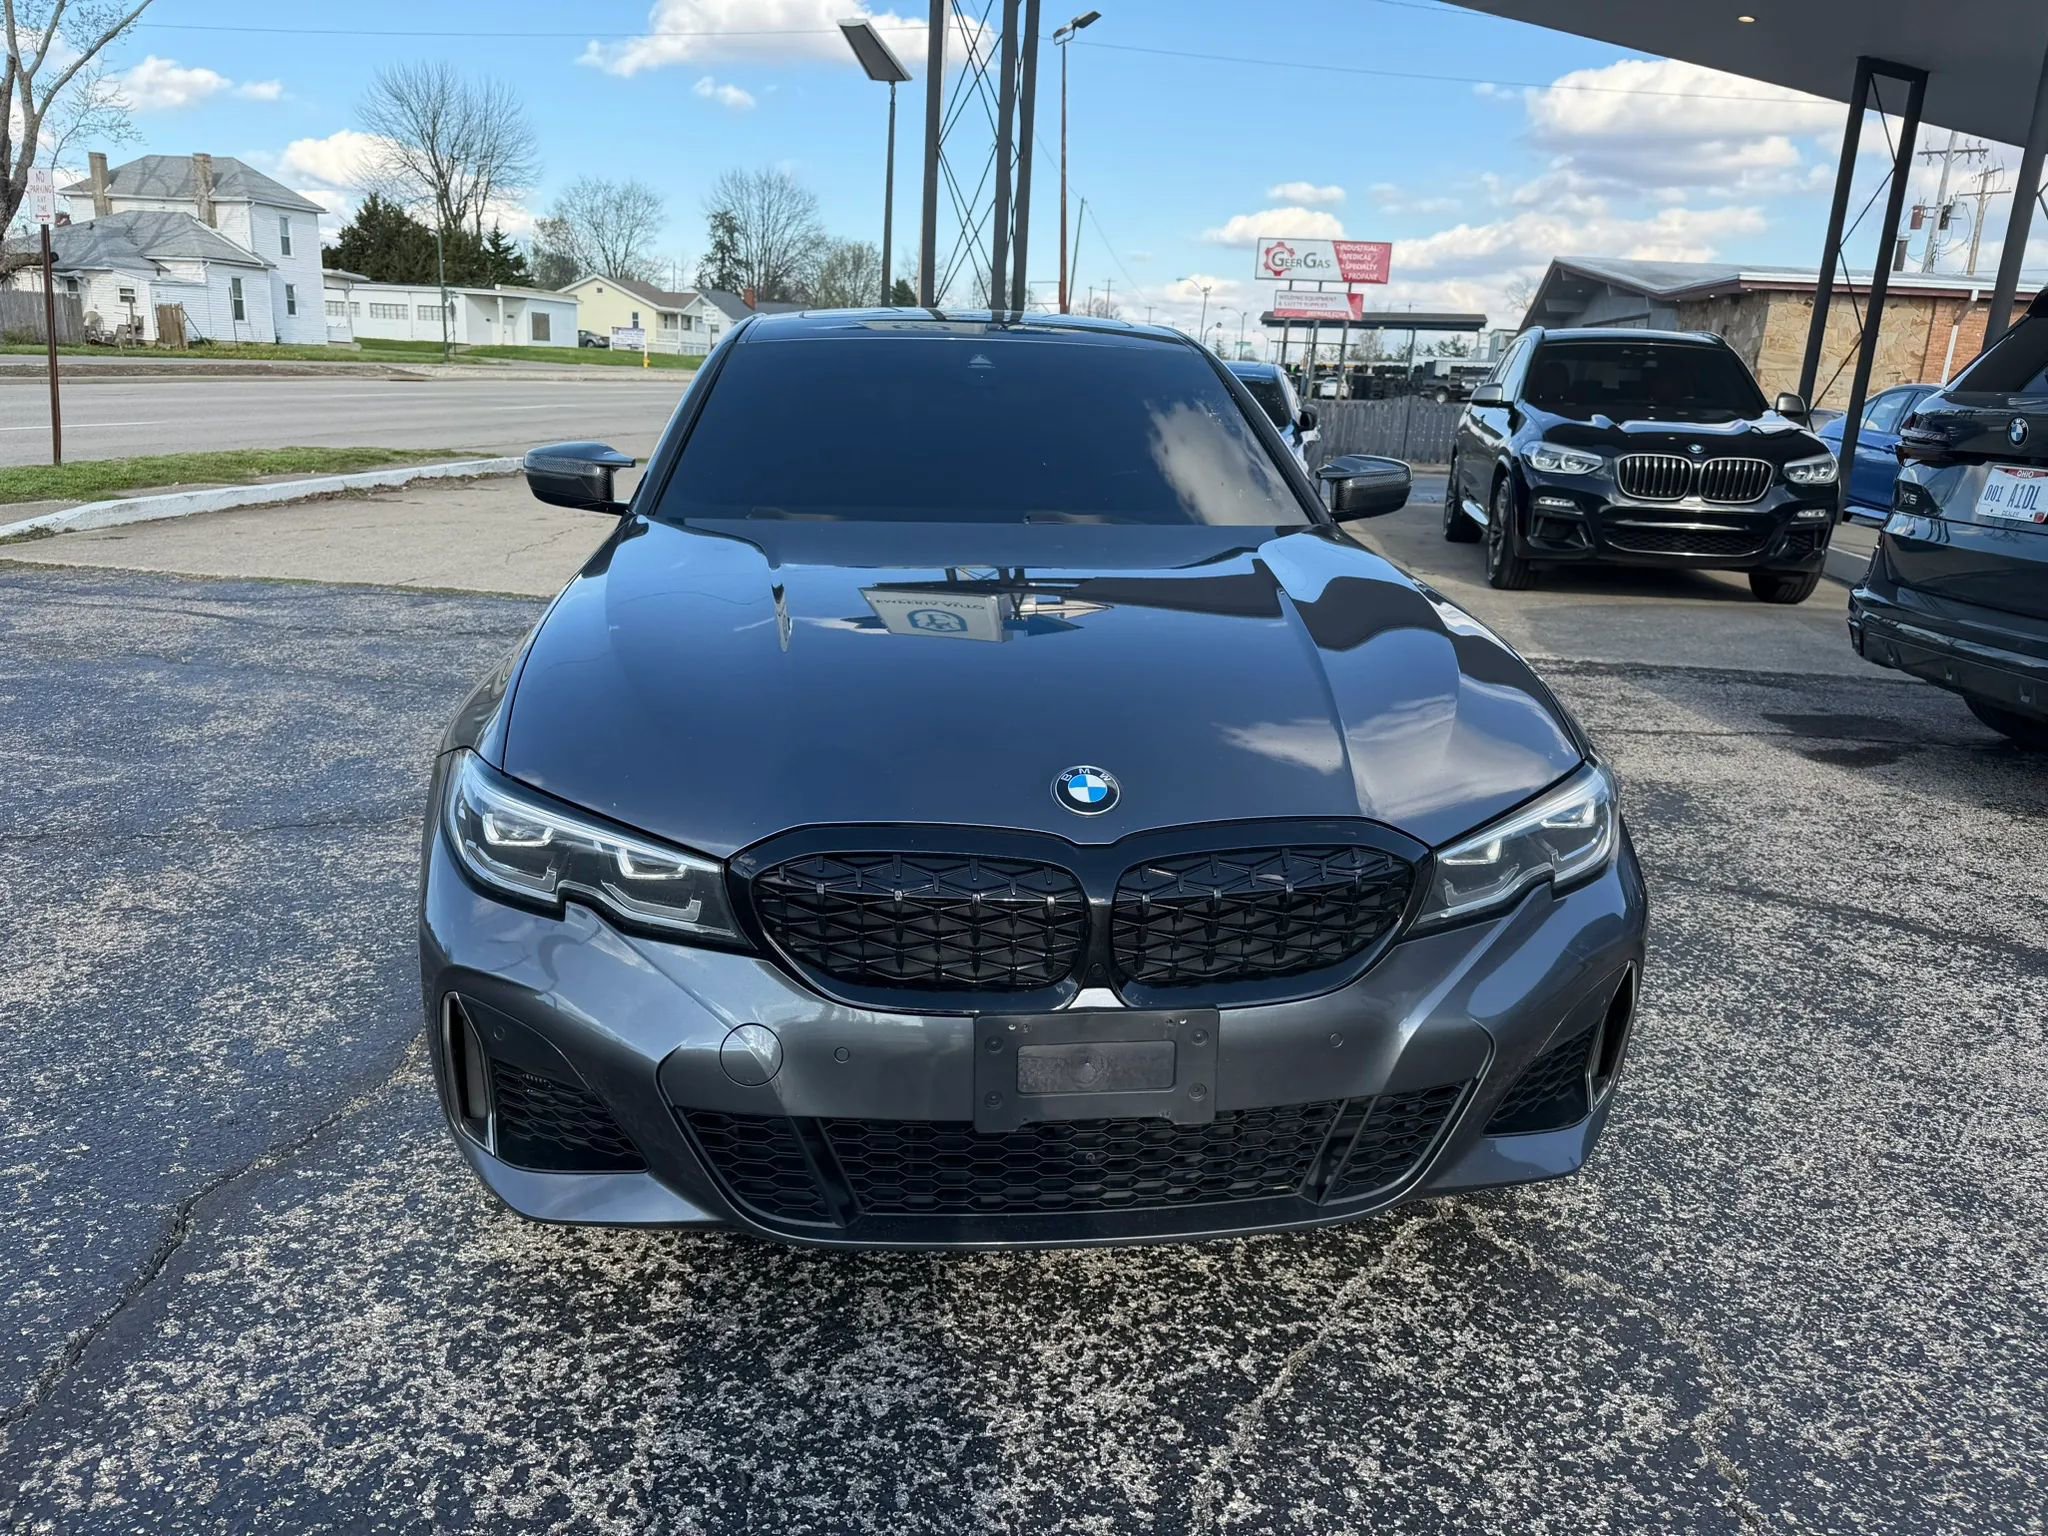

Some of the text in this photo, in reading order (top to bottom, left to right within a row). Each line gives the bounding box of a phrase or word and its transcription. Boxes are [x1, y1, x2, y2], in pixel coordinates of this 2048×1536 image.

[36, 172, 45, 183] NO
[30, 184, 52, 194] PARKING
[2016, 470, 2034, 478] OHIO
[1903, 492, 1917, 505] X5
[1984, 483, 2041, 511] 001 A1DL
